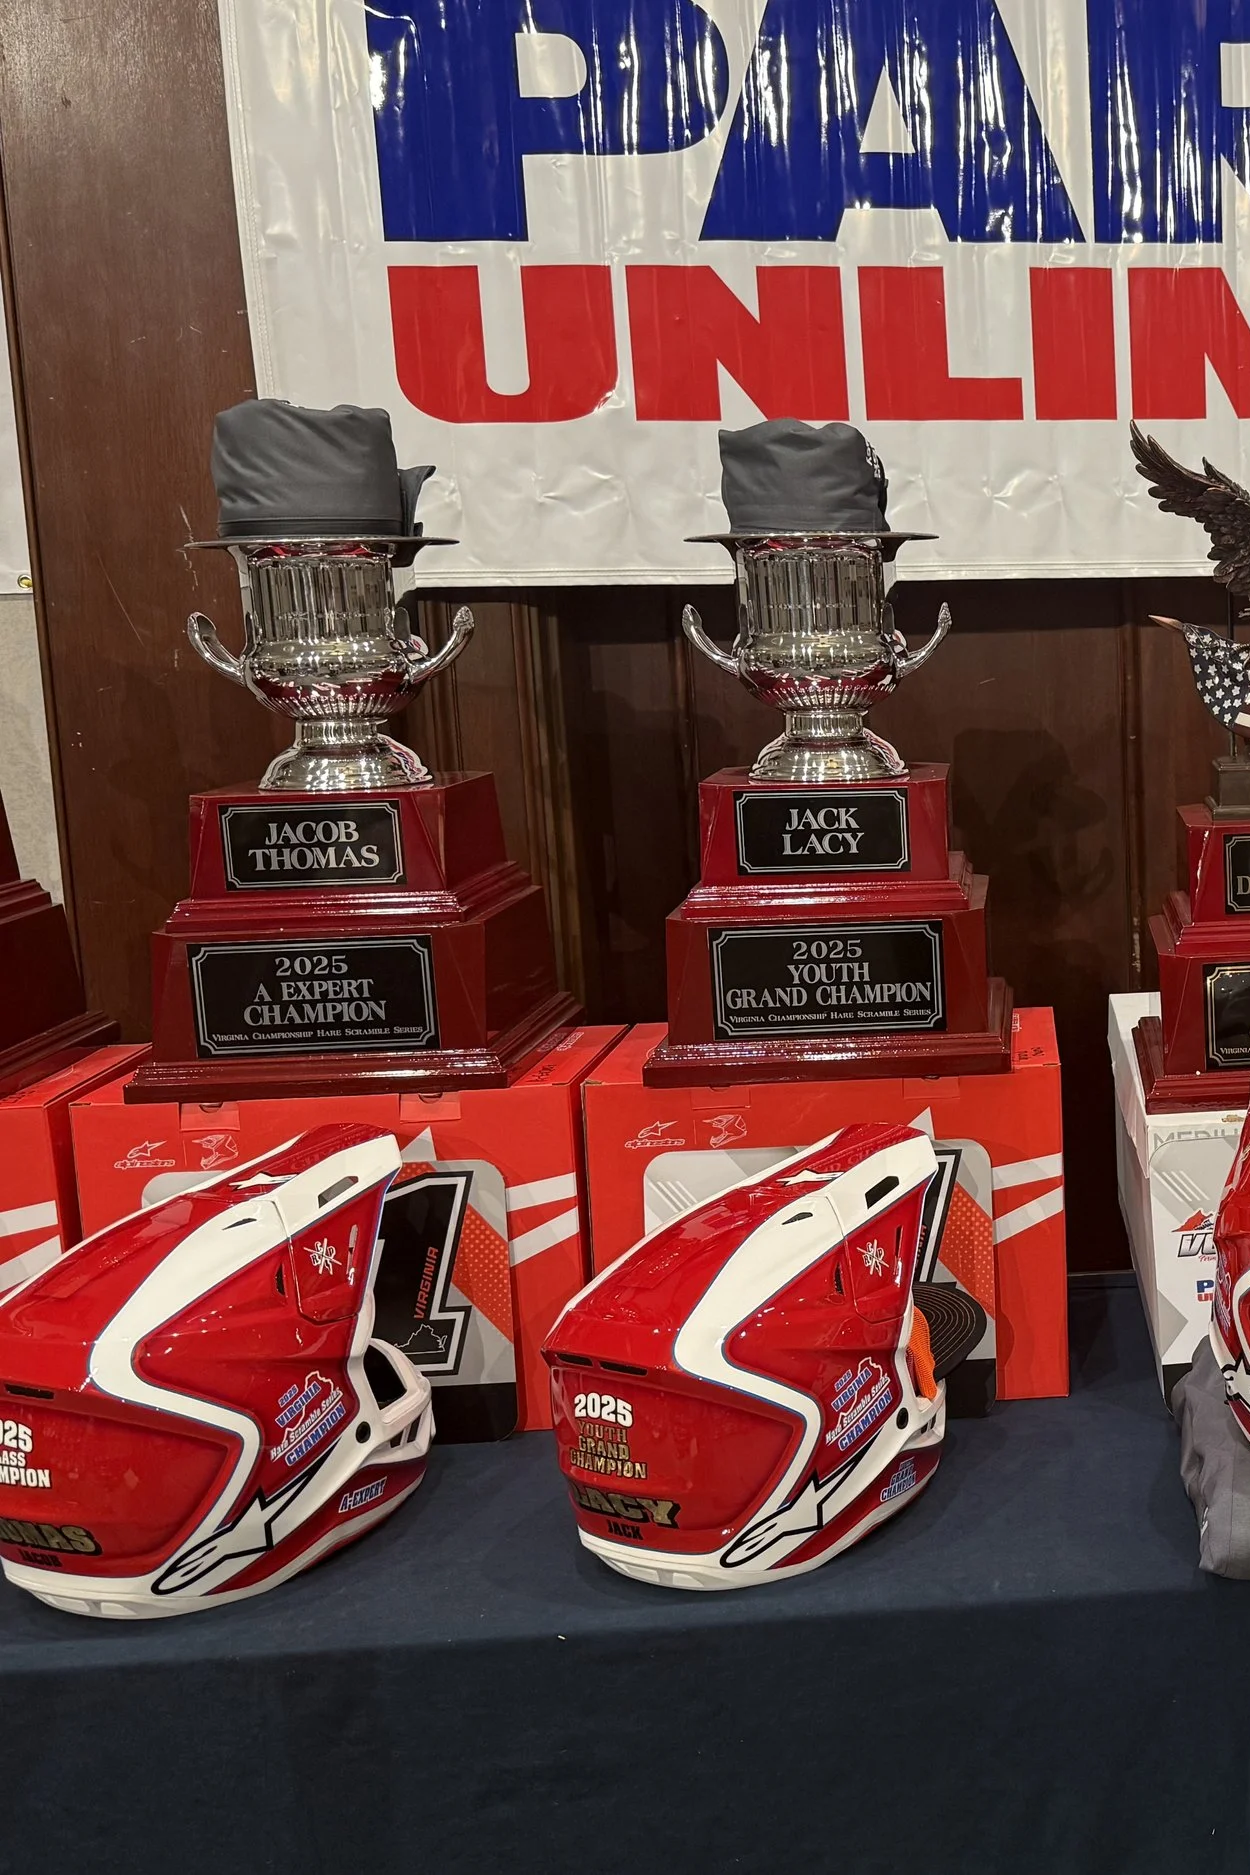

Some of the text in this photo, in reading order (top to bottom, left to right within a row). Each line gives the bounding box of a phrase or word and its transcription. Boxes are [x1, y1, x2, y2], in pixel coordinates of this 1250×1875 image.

[785, 807, 860, 831] JACK
[265, 820, 360, 845] JACOB
[781, 831, 864, 856] LACY
[248, 846, 380, 872] THOMAS
[792, 939, 863, 960] 2025
[275, 955, 348, 977] 2025
[787, 962, 871, 984] YOUTH
[254, 979, 374, 1002] A EXPERT
[725, 982, 932, 1009] GRAND CHAMPION
[243, 1000, 387, 1026] CHAMPION
[414, 1246, 439, 1319] VIRGINIA
[831, 1366, 872, 1412] VIRGINIA
[275, 1381, 322, 1428] VIRGINIA
[574, 1392, 634, 1428] 2025
[577, 1420, 627, 1443] YOUTH
[838, 1388, 893, 1451] CHAMPION
[285, 1401, 346, 1467] CHAMPION
[578, 1435, 629, 1460] GRAND
[570, 1448, 648, 1479] CHAMPION
[570, 1483, 681, 1528] LACY
[607, 1520, 644, 1540] JACK
